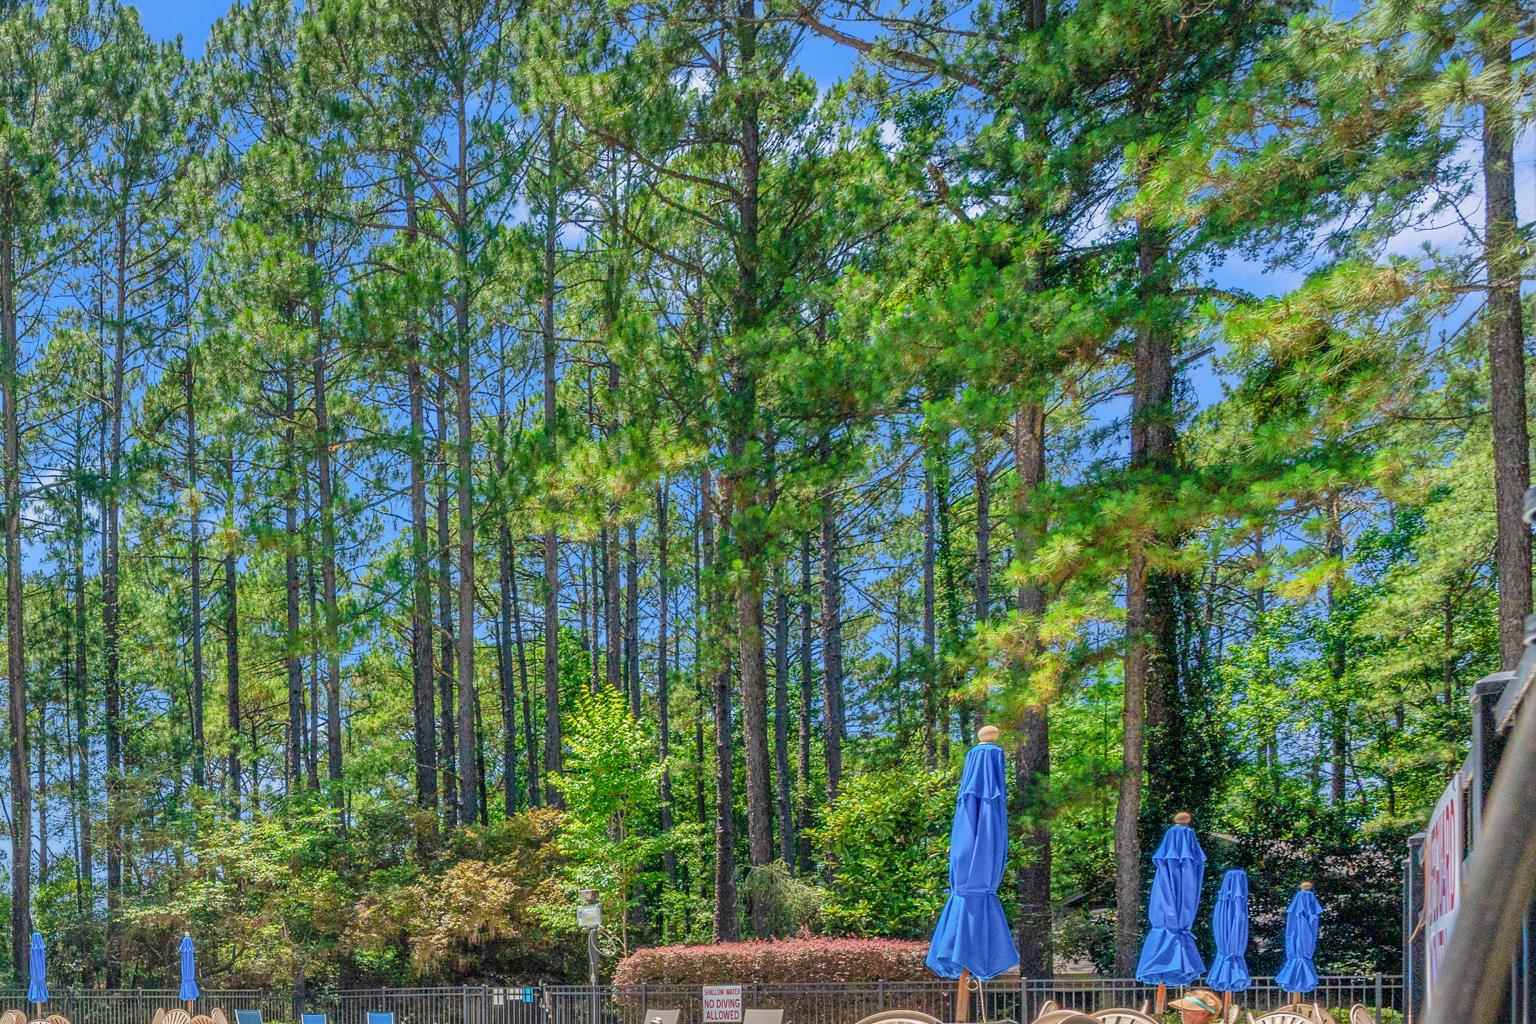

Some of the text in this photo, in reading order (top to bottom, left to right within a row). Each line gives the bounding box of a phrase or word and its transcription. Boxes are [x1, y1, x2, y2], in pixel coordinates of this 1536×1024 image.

[704, 999, 740, 1009] NO DIVING
[706, 1010, 740, 1020] ALLOWED
